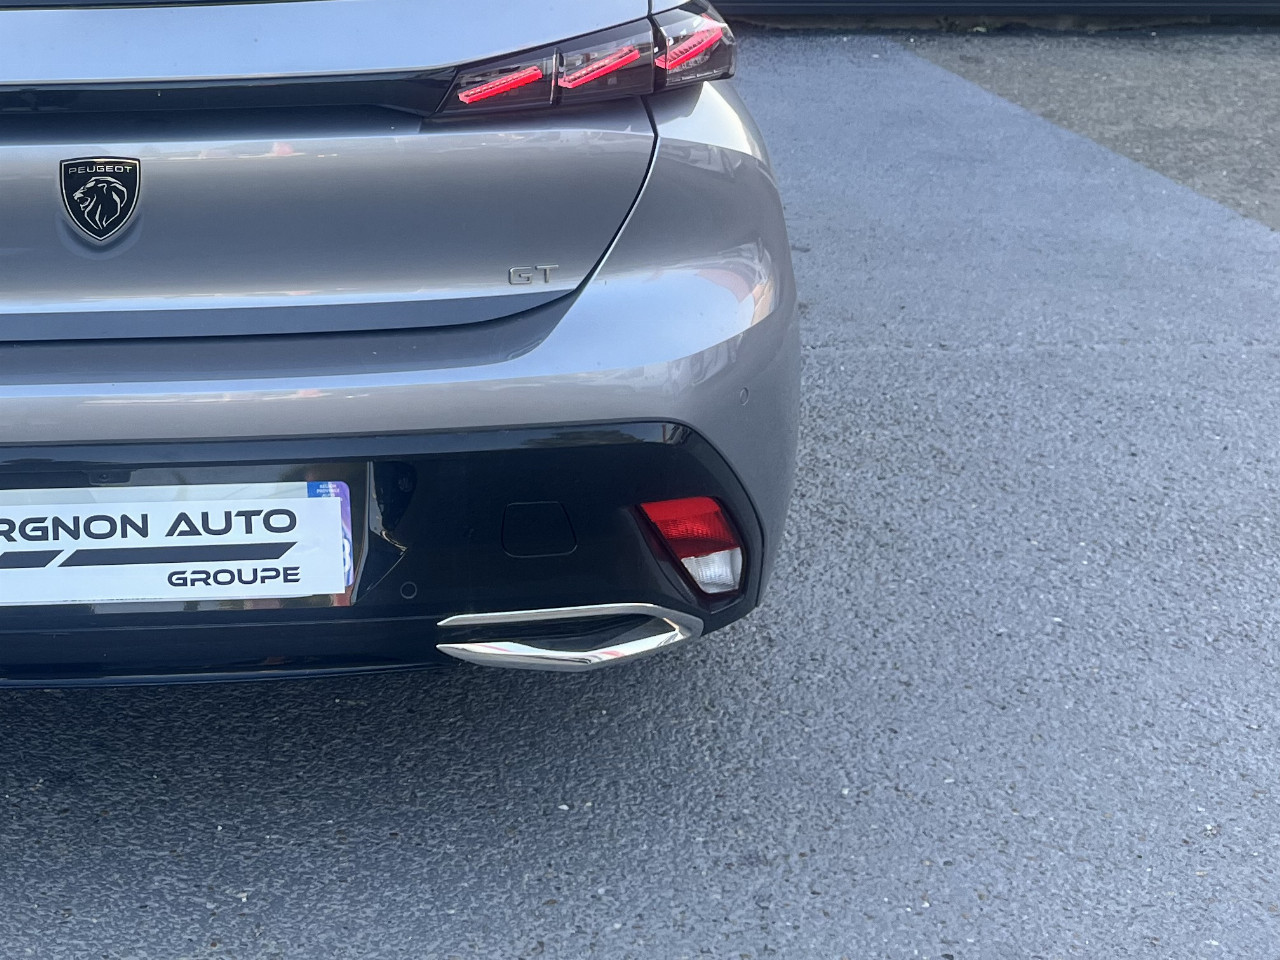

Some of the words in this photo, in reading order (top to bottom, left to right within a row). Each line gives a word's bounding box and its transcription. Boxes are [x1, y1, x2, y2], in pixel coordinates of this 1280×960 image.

[68, 165, 133, 174] PEUGEOT
[508, 264, 559, 285] GT
[165, 508, 297, 537] AUTO
[167, 567, 301, 587] GROUPE
